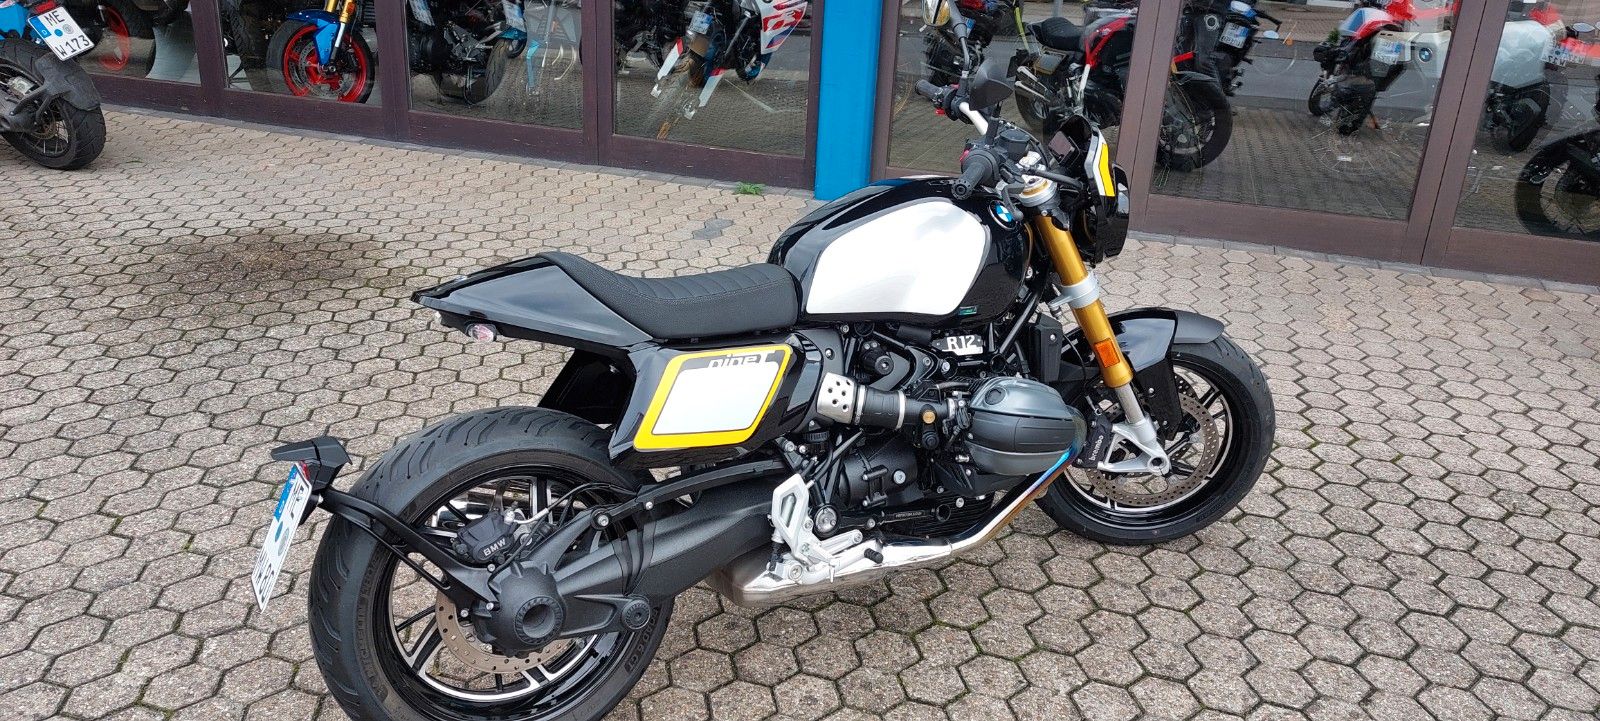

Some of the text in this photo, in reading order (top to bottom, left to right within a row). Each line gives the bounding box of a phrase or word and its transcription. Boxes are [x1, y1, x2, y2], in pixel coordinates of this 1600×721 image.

[44, 10, 65, 26] ME
[55, 34, 90, 57] W 173
[1088, 434, 1104, 461] brembo
[483, 538, 506, 557] BMW
